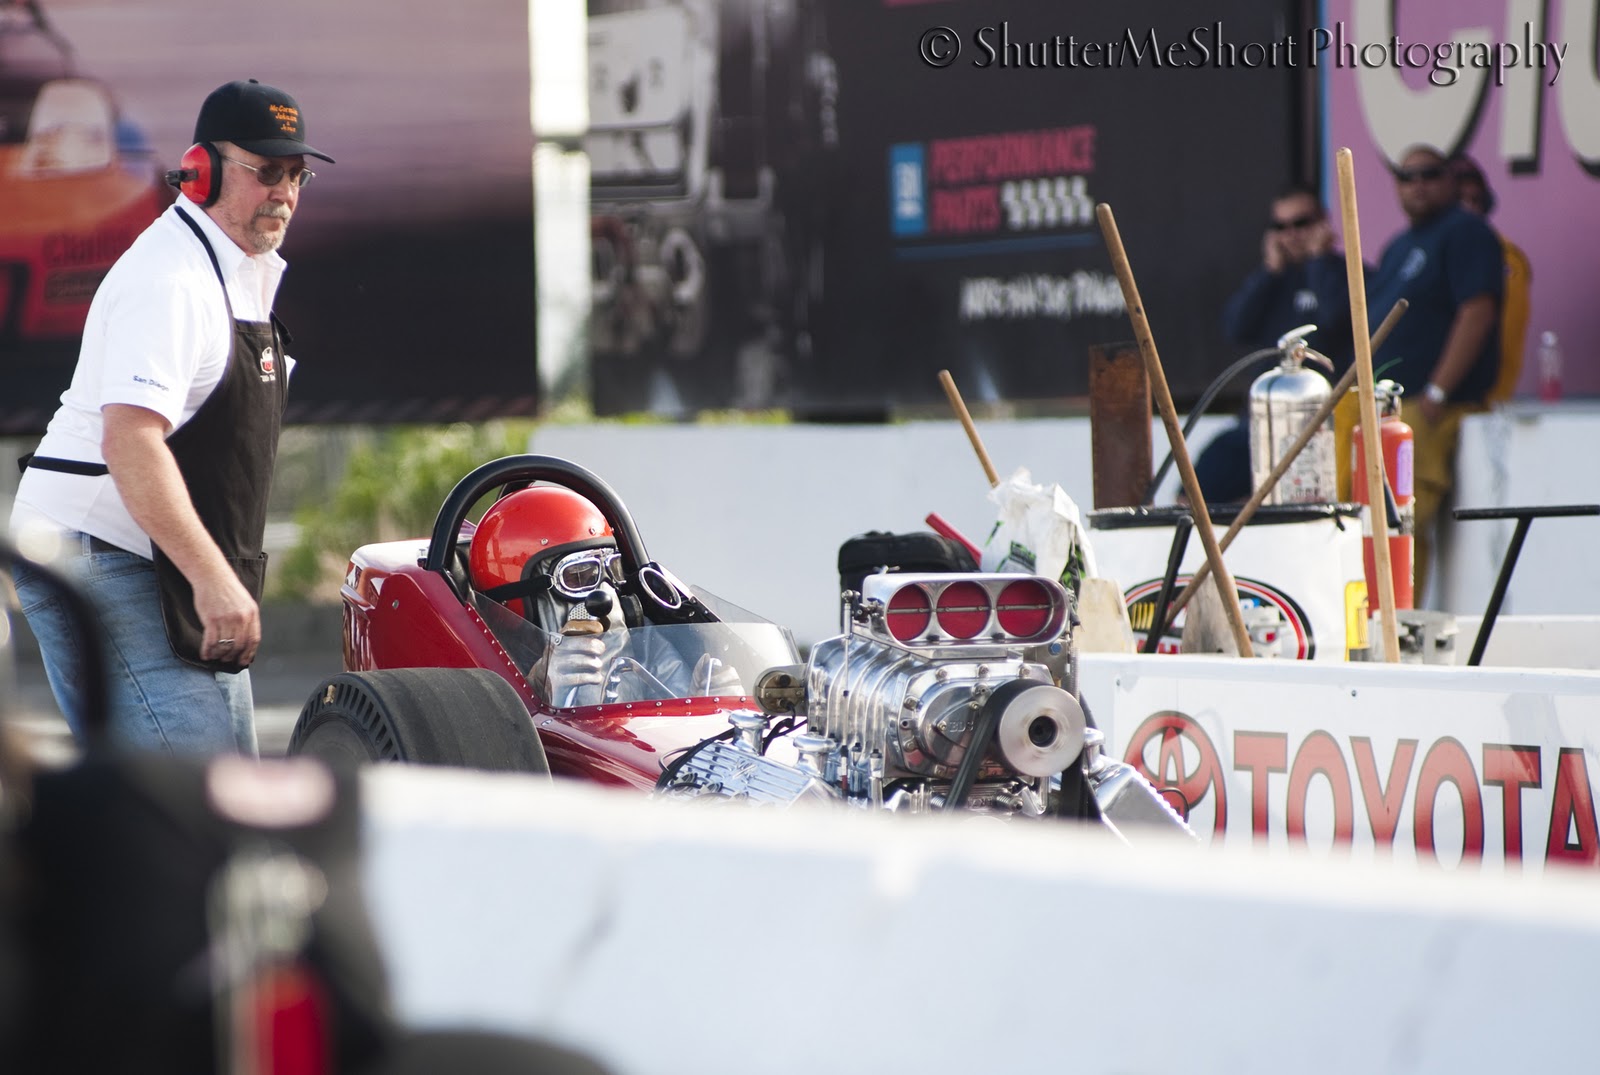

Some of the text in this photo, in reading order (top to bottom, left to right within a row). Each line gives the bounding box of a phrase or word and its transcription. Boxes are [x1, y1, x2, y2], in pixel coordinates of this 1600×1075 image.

[133, 375, 170, 392] San Diego
[1233, 729, 1600, 872] TOYOTA
